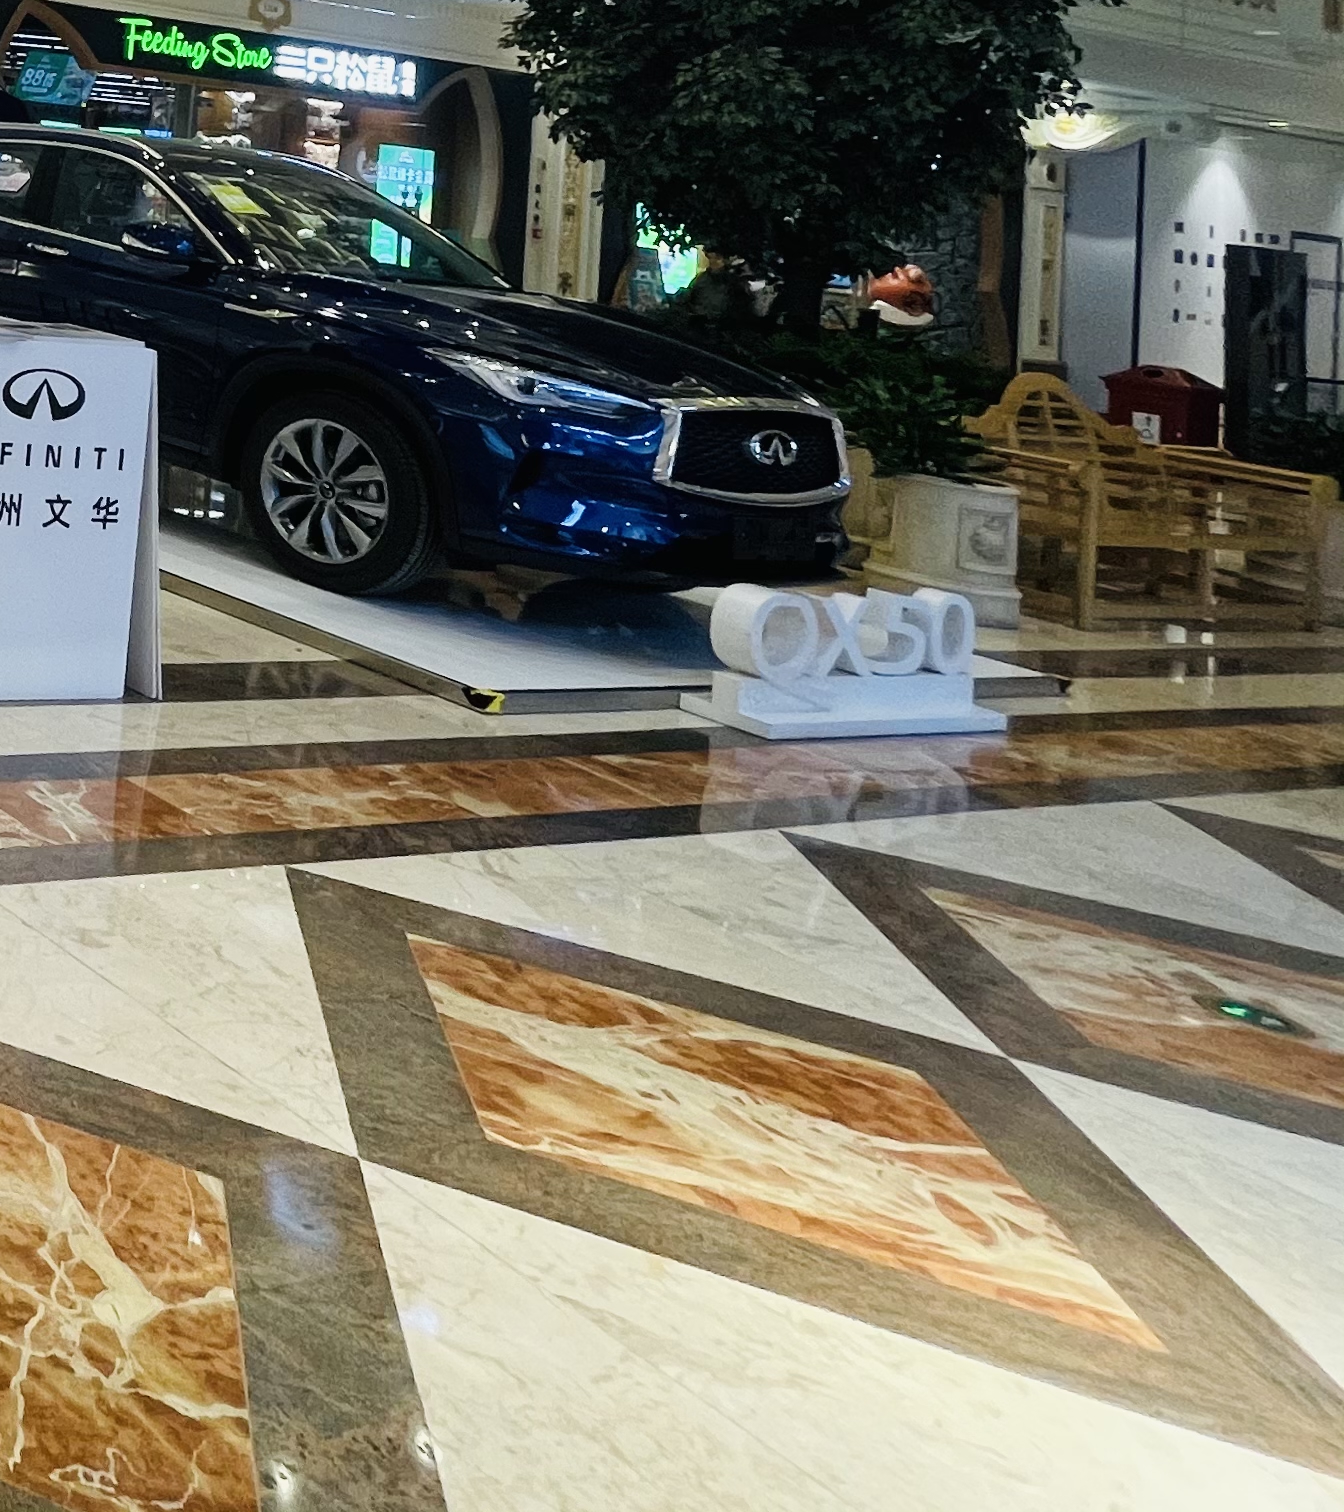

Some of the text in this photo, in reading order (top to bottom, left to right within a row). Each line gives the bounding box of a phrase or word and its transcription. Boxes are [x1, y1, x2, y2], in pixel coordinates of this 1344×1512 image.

[116, 18, 210, 70] Feeding
[211, 33, 273, 70] Store
[711, 584, 976, 710] QX50
